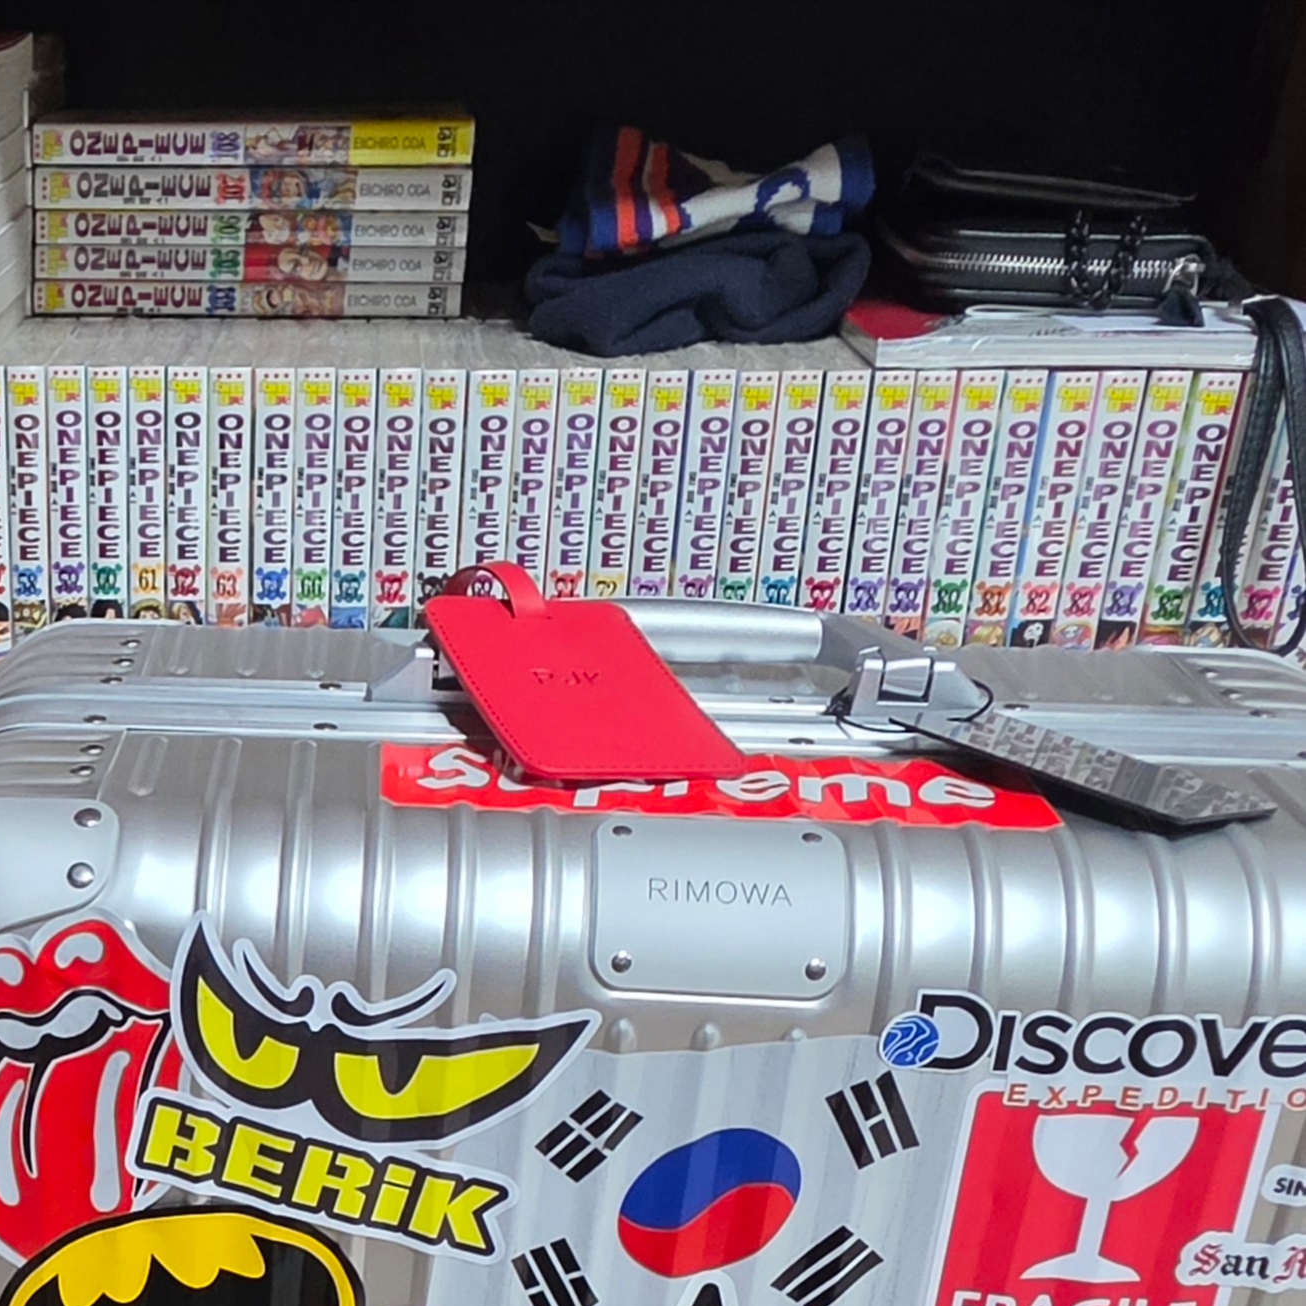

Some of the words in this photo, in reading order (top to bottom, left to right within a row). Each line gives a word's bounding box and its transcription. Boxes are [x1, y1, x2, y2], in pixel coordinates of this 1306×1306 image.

[70, 129, 118, 156] ONE
[122, 131, 205, 156] PIECE
[74, 213, 122, 238] ONE
[126, 214, 208, 238] PIECE
[74, 246, 122, 271] ONE
[125, 248, 207, 272] PIECE
[13, 414, 40, 467] ONE
[135, 409, 163, 463] ONE
[218, 413, 244, 468] ONE
[1056, 420, 1087, 478] ONE
[17, 472, 41, 561] PIECE
[137, 469, 162, 558] PIECE
[217, 474, 242, 563] PIECE
[1036, 483, 1074, 577] PIECE
[138, 569, 158, 590] 61
[216, 575, 238, 596] 63
[1026, 589, 1049, 614] 82
[417, 747, 997, 809] Seme
[648, 876, 794, 908] RIMOWA
[1188, 1243, 1270, 1280] San
